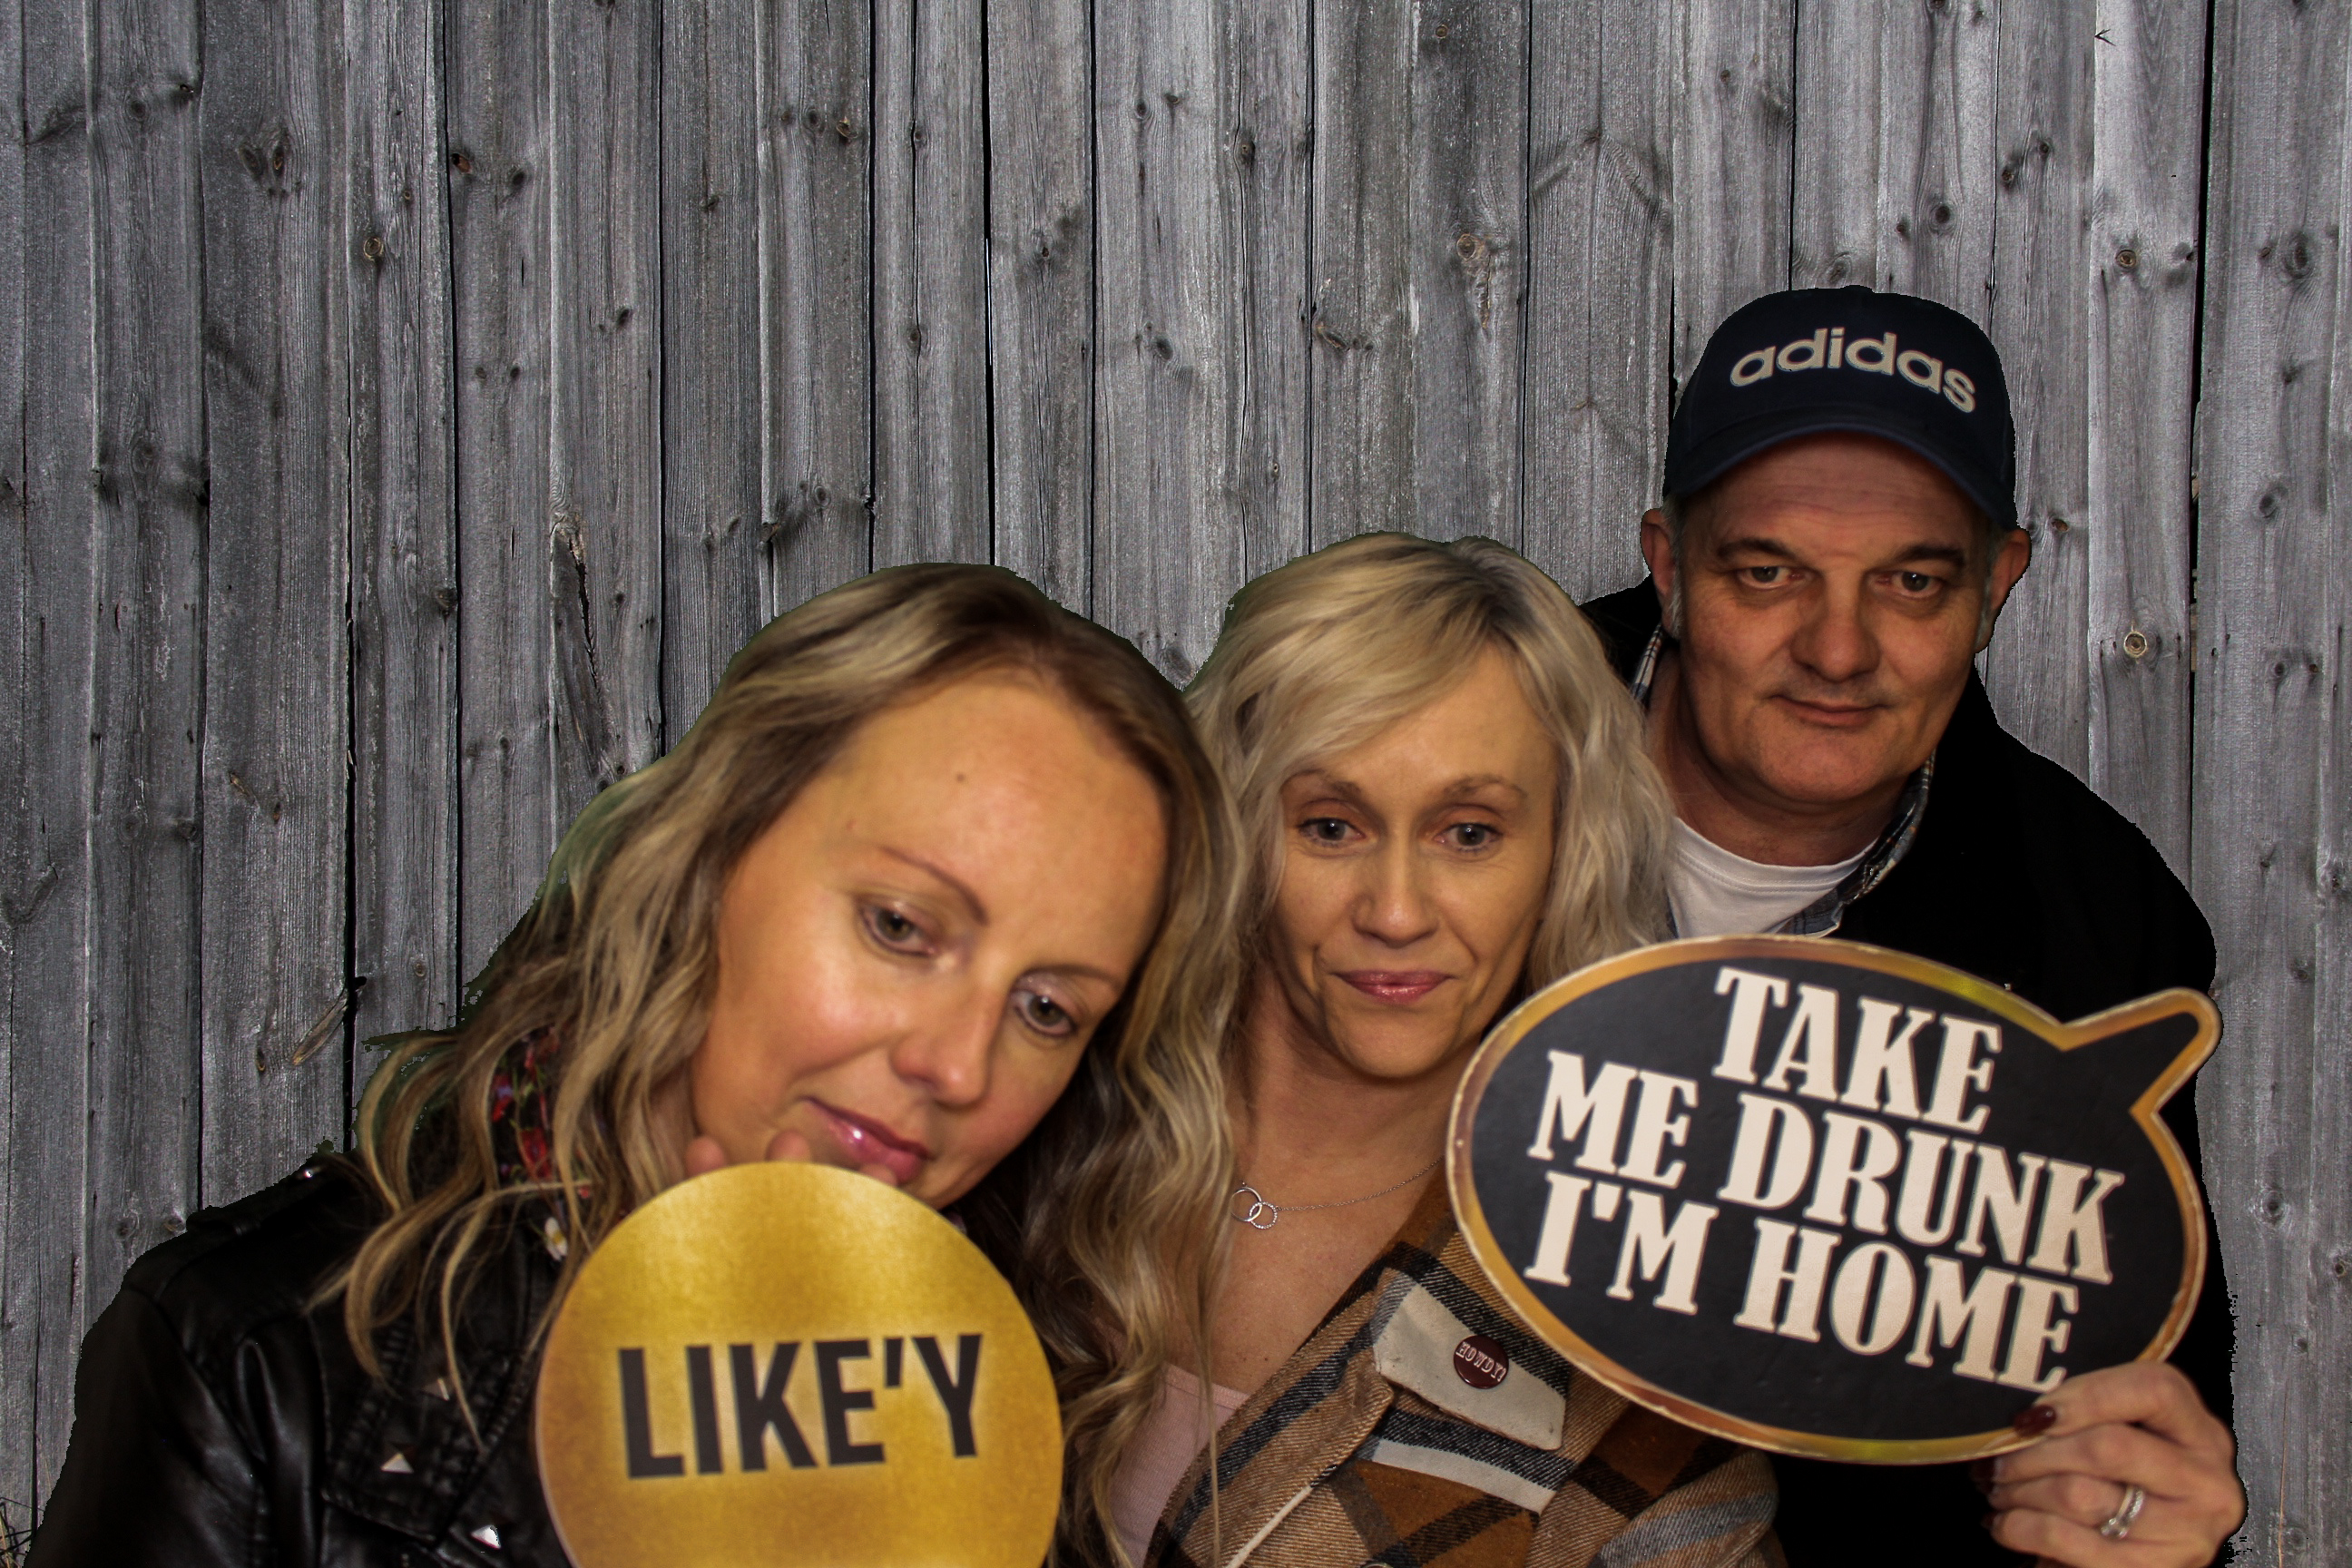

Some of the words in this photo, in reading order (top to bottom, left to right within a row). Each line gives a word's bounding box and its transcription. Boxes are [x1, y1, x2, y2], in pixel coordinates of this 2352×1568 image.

[1730, 327, 1976, 413] adidas
[1712, 966, 2002, 1134] TAKE
[1527, 1049, 1699, 1189] ME
[1717, 1093, 2124, 1284] DRUNK
[1524, 1170, 1719, 1315] I'M
[1733, 1217, 2080, 1393] HOME
[618, 1333, 984, 1480] LIKE'Y
